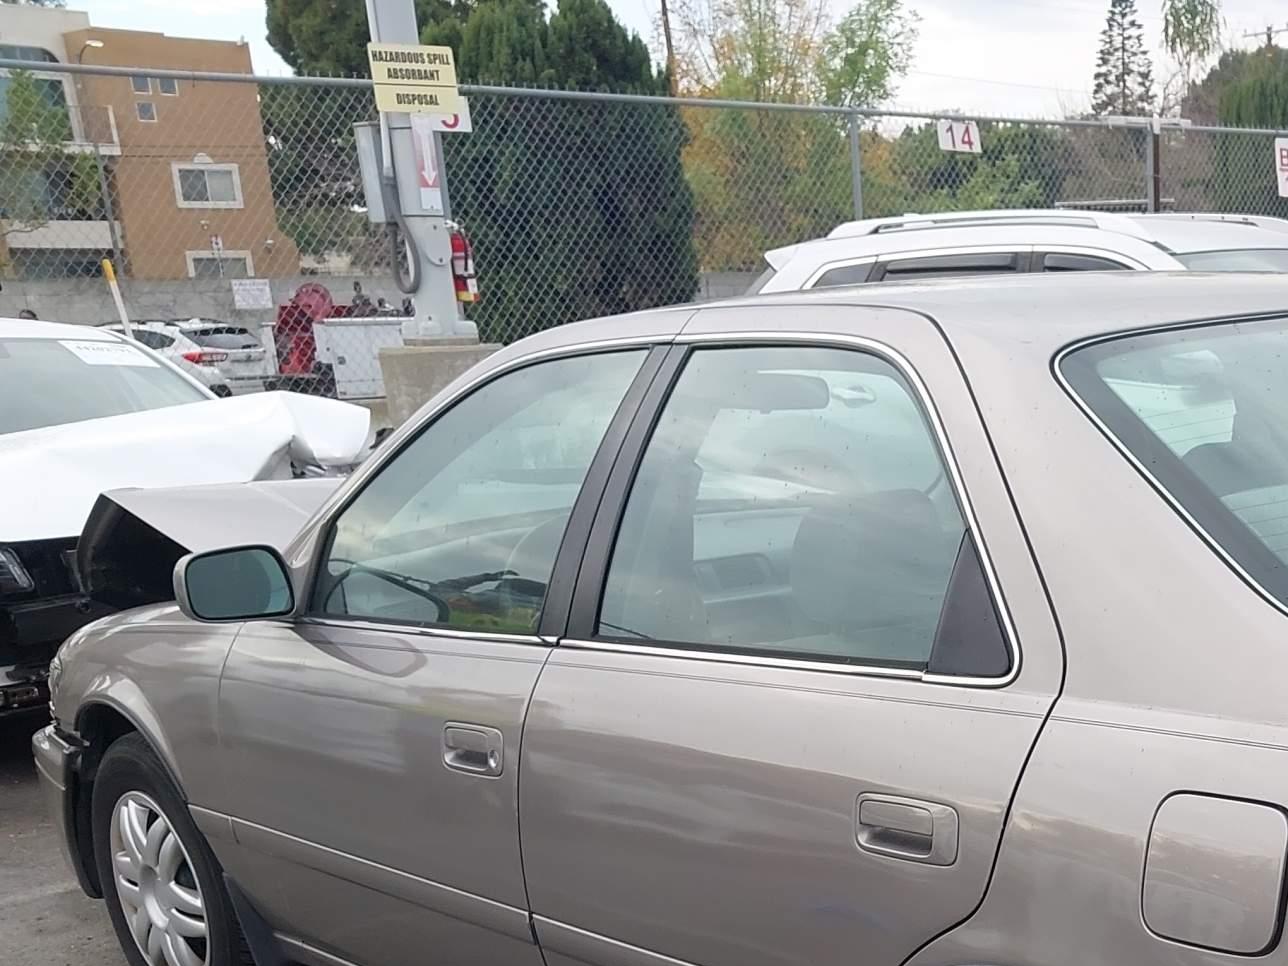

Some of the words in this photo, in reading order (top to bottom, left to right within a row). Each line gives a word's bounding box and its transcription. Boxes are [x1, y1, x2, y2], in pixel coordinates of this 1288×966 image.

[371, 50, 425, 65] HAZARDOUS
[427, 52, 451, 66] SPILL
[387, 67, 440, 81] ABSORBANT
[396, 93, 440, 106] DISPOSAL
[946, 123, 974, 150] 14
